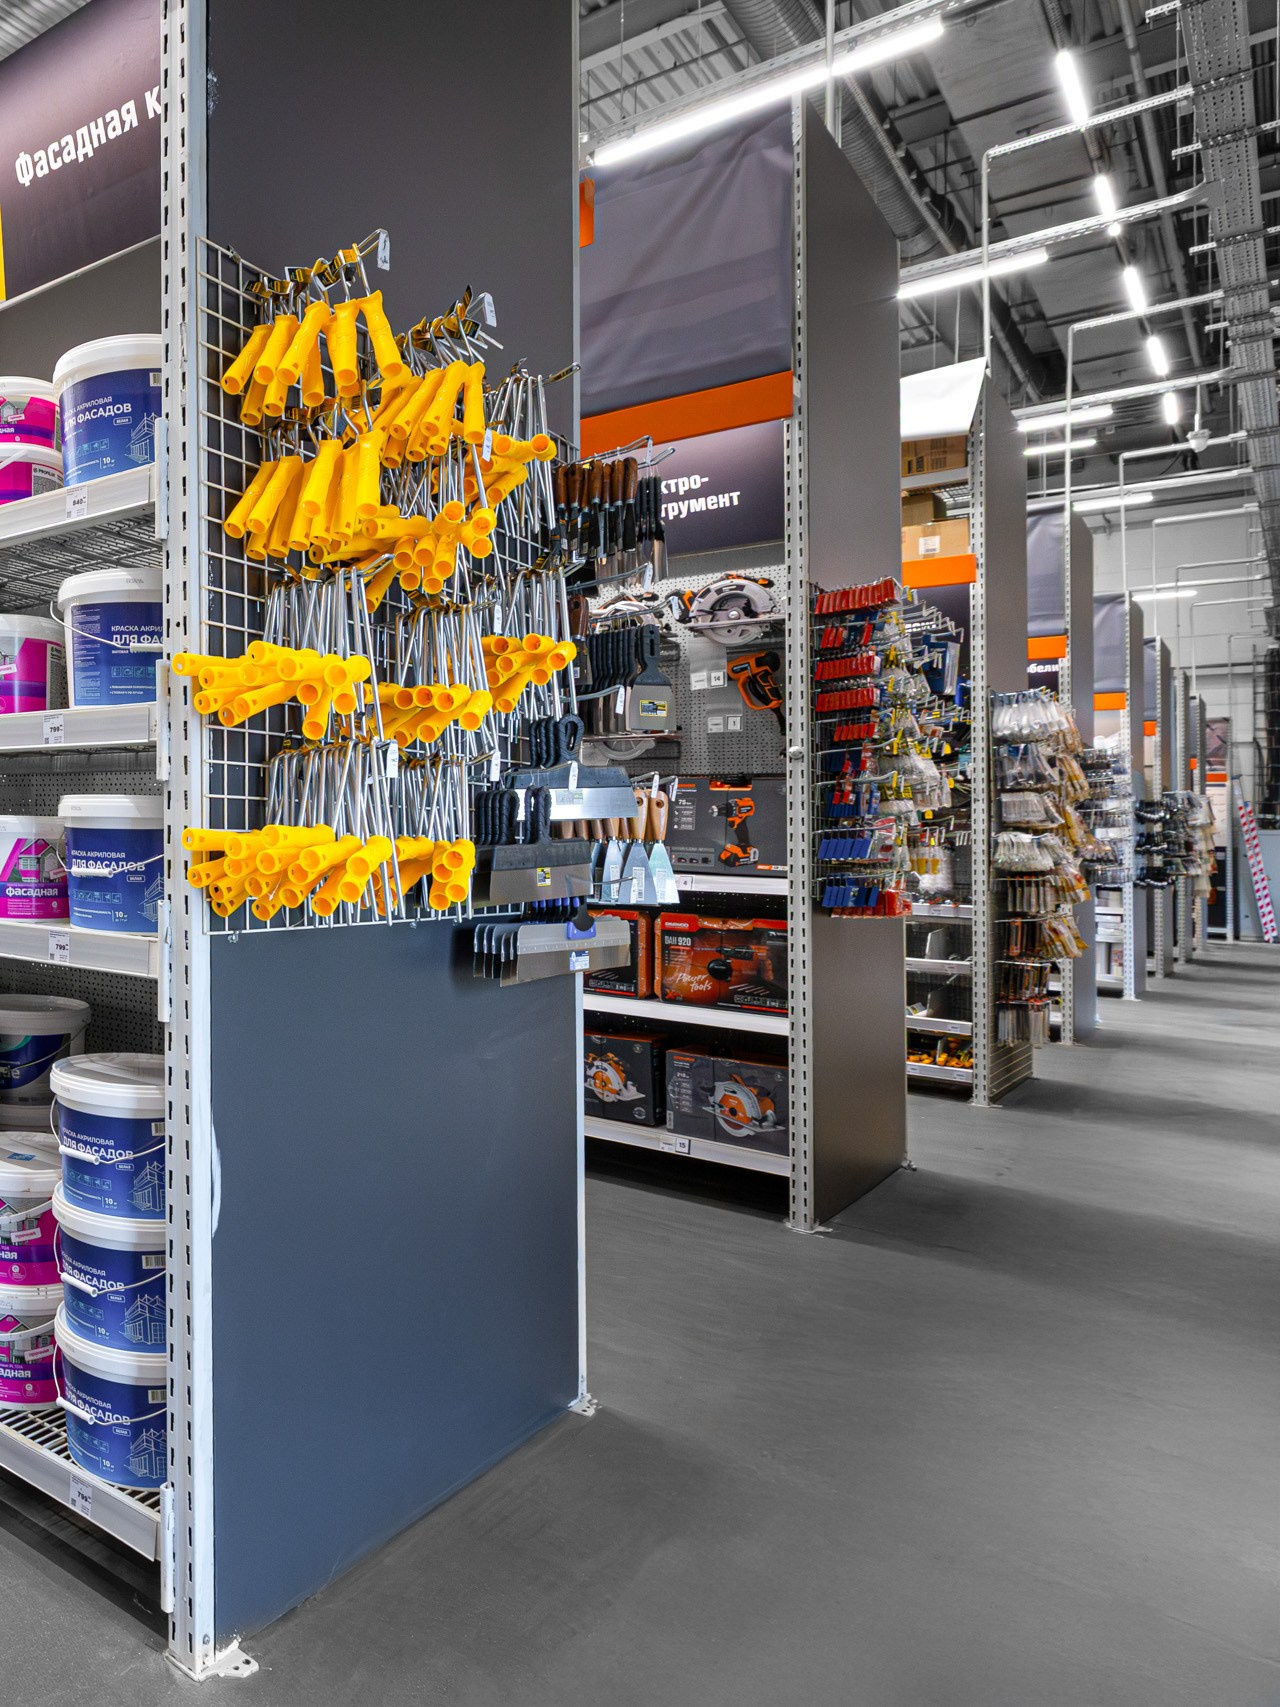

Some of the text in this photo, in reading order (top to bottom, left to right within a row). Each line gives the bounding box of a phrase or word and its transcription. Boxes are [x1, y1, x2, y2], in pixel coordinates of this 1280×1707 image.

[15, 85, 161, 187] Фасадная к
[77, 403, 132, 424] ФАСАДОВ
[660, 474, 709, 495] ктро-
[660, 491, 741, 519] трумент
[112, 634, 138, 646] ДЛЯ
[1026, 663, 1059, 674] бели
[87, 860, 146, 872] ФАСАДОВ
[6, 886, 58, 897] фасадная
[678, 936, 692, 946] 920
[77, 1134, 114, 1146] АКРИЛОВАЯ
[78, 1143, 134, 1160] ФАСАДОВ
[73, 1270, 125, 1291] ФАСАДОВ
[98, 1327, 106, 1335] 10
[77, 1400, 131, 1426] ФАСАДОВ
[102, 1459, 111, 1467] 10
